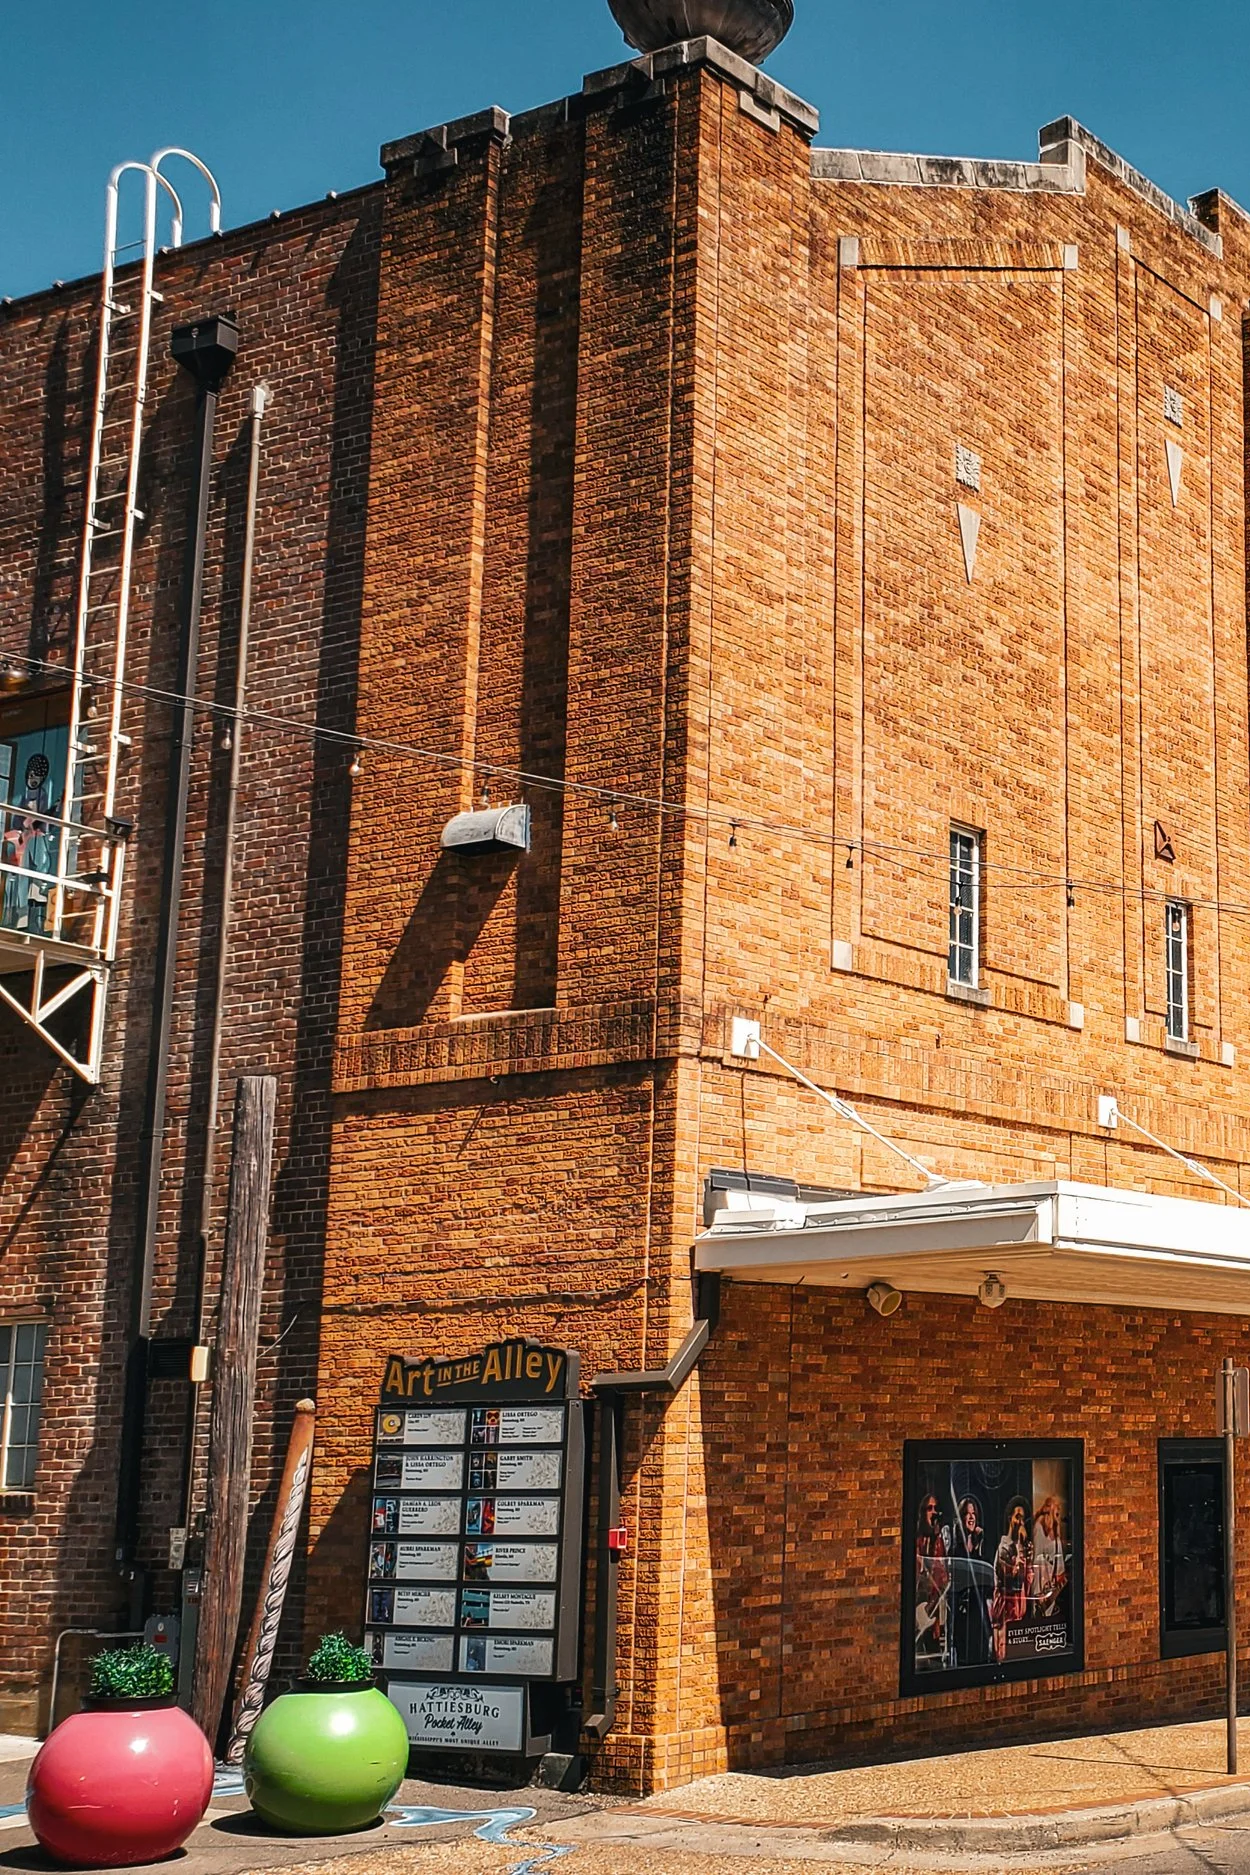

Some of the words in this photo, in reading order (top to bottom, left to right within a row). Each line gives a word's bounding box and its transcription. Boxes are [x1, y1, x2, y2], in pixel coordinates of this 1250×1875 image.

[386, 1360, 434, 1396] Art
[437, 1367, 452, 1382] IN
[455, 1360, 480, 1379] THE
[481, 1344, 563, 1393] Alley
[1008, 1628, 1024, 1637] EVERY
[1025, 1625, 1052, 1634] SPOTLIGHT
[1053, 1623, 1067, 1631] TELLS
[1039, 1637, 1063, 1646] SAENGER
[409, 1701, 500, 1719] HATTIESBURG
[424, 1713, 456, 1730] Pocket
[456, 1715, 483, 1736] Alley
